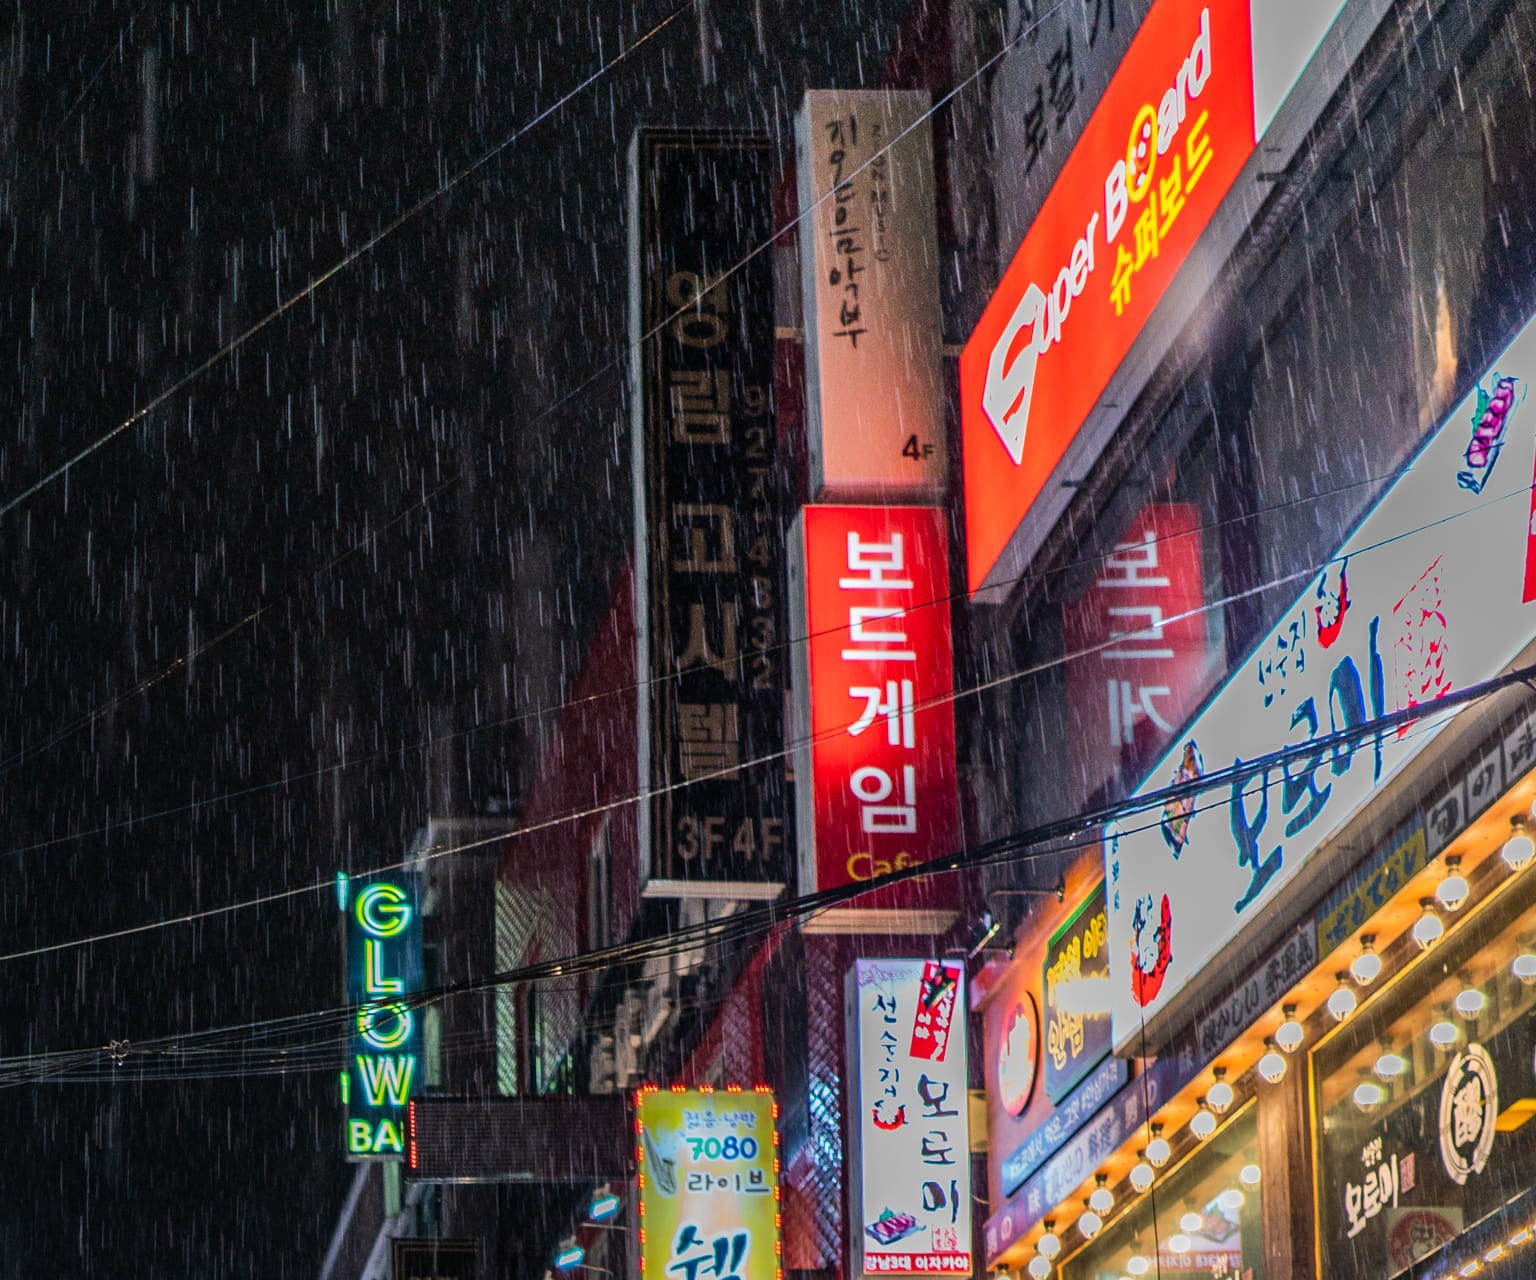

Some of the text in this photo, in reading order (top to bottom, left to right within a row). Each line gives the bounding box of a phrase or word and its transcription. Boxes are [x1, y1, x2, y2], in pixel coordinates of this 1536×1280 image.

[1109, 108, 1215, 317] 슈퍼보드
[981, 210, 1101, 467] Super
[902, 433, 936, 462] 4F
[838, 531, 918, 835] 보드게임
[355, 883, 414, 1107] GLOW
[872, 994, 901, 1098] 선술집
[348, 1118, 405, 1155] BA
[688, 1171, 771, 1193] 라이브
[689, 1136, 757, 1161] 7080
[917, 1073, 960, 1224] 모로미
[865, 1253, 970, 1272] 강남3대 이자카야
